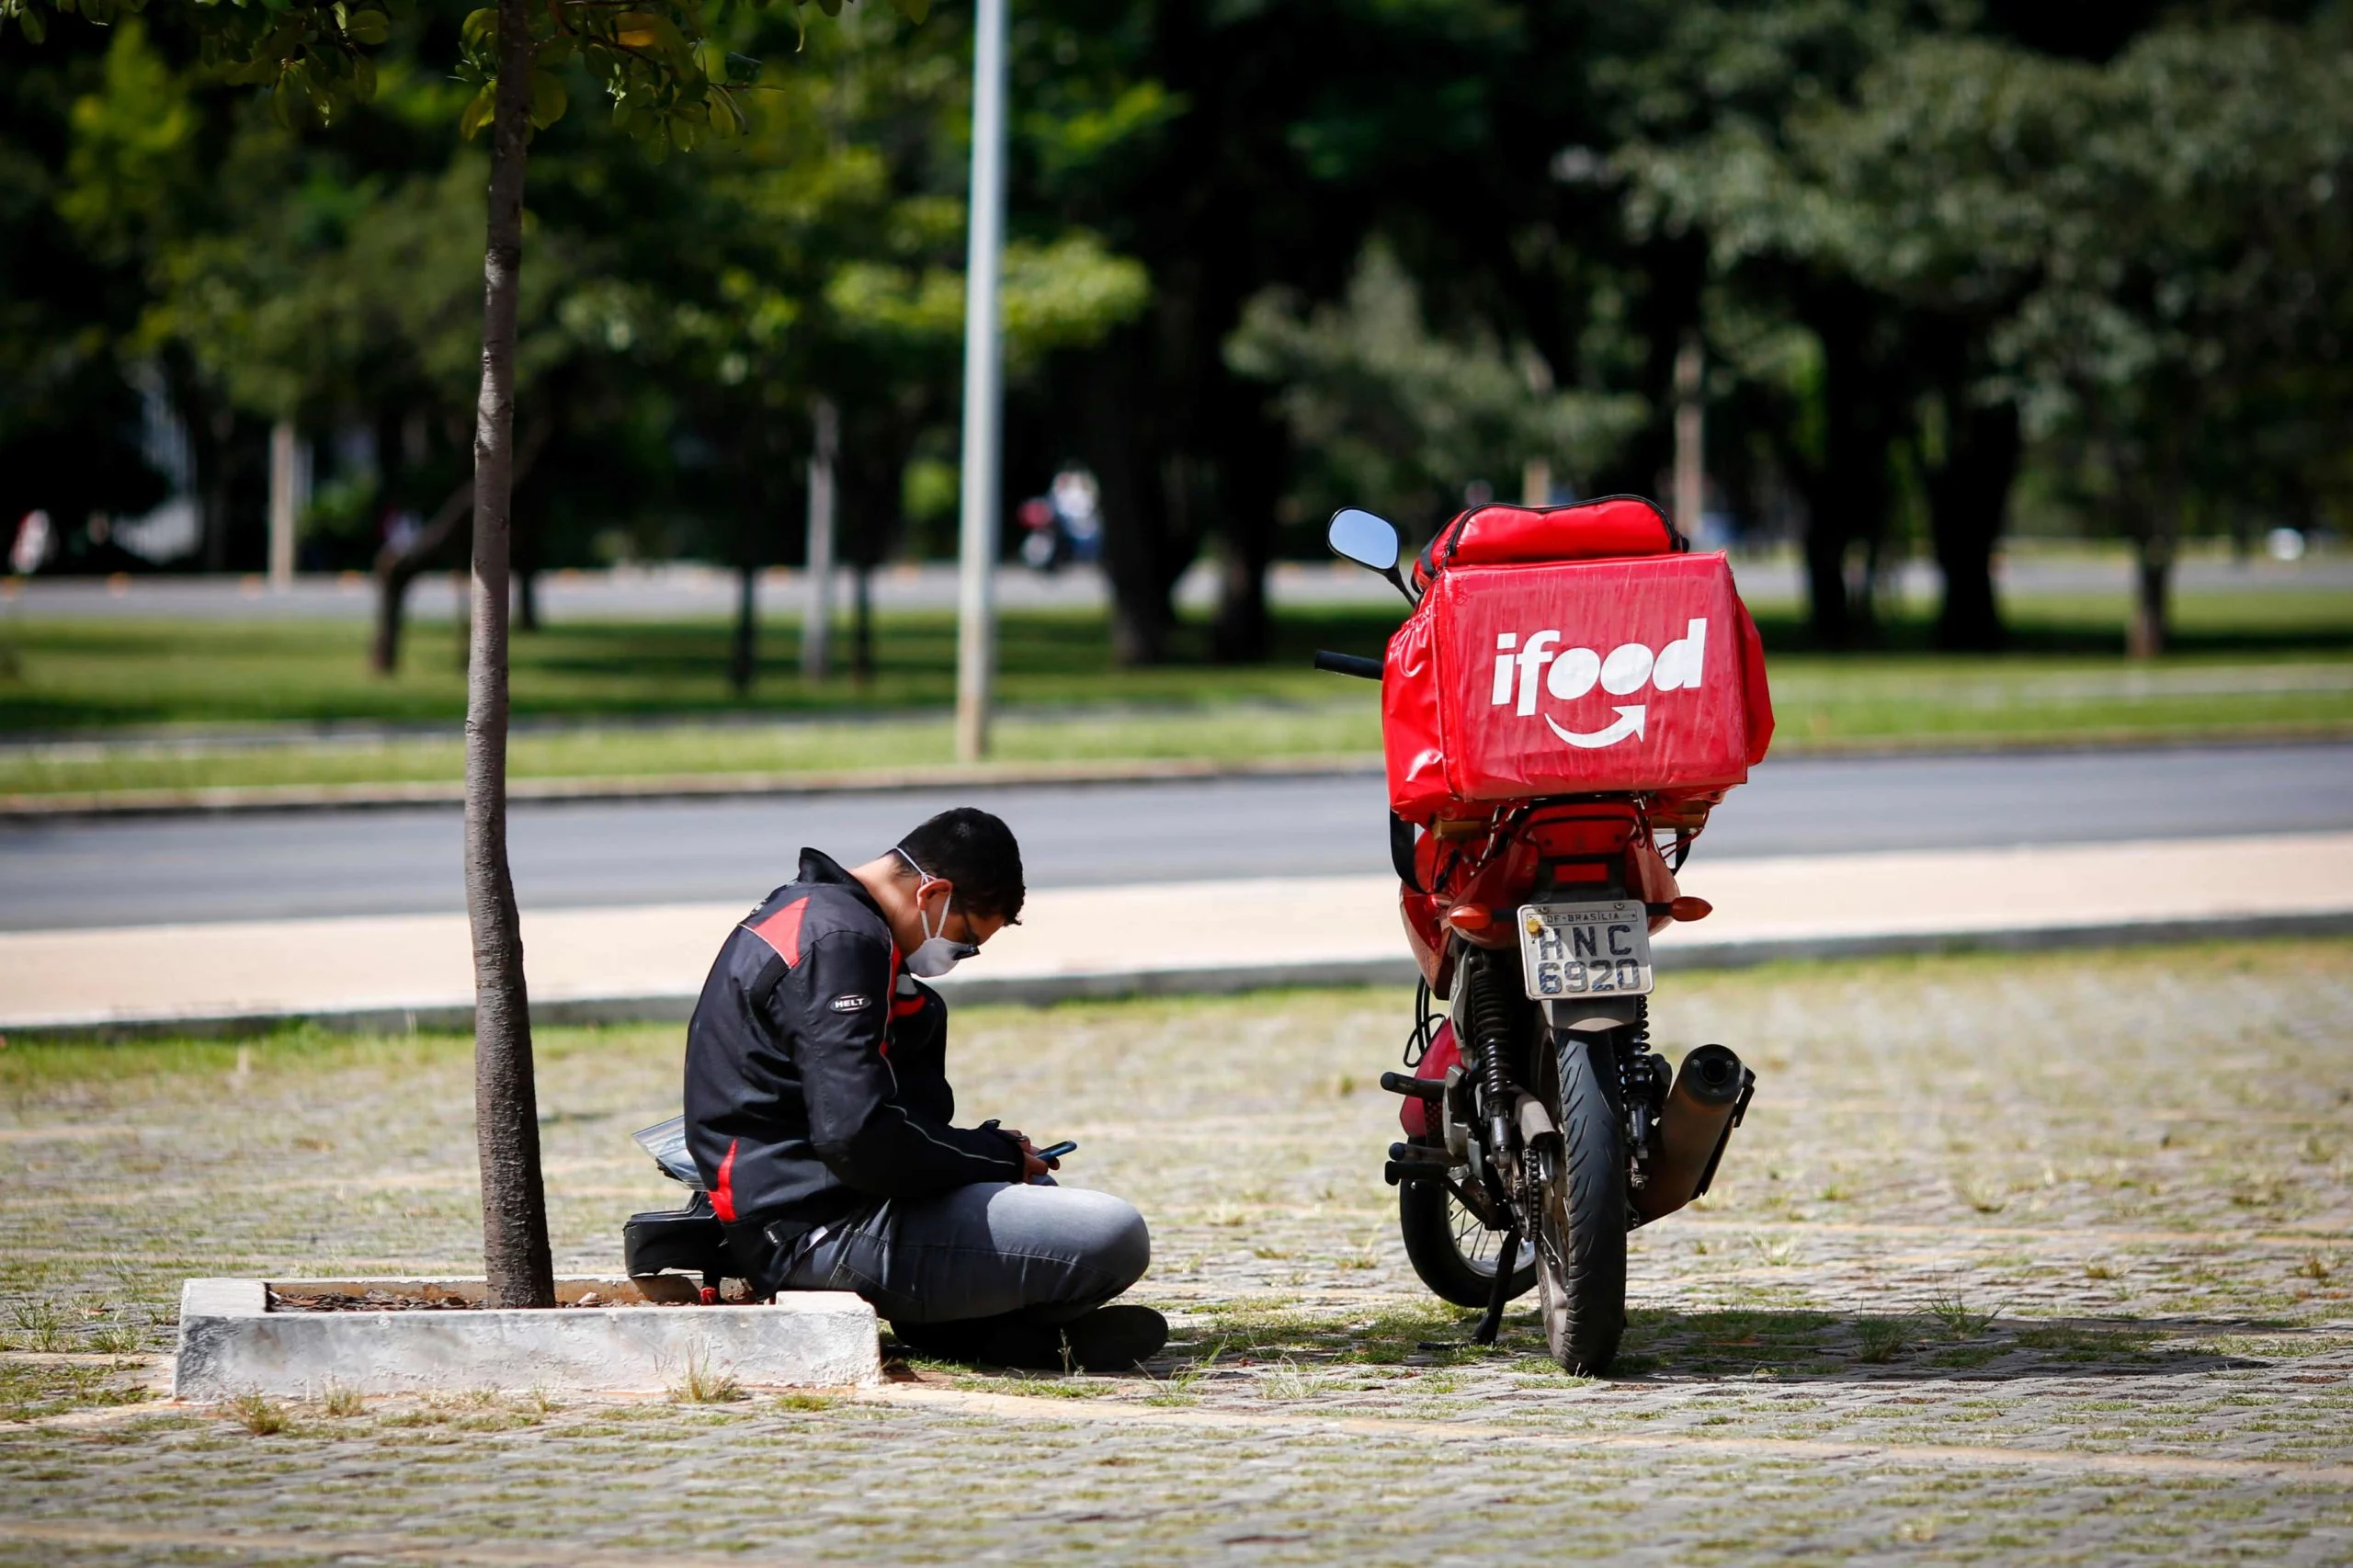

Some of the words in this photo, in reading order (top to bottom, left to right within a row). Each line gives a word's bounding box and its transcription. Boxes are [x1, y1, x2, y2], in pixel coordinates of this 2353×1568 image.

[1492, 618, 1707, 717] ifood
[1538, 958, 1640, 994] 6920
[835, 998, 865, 1008] HELT
